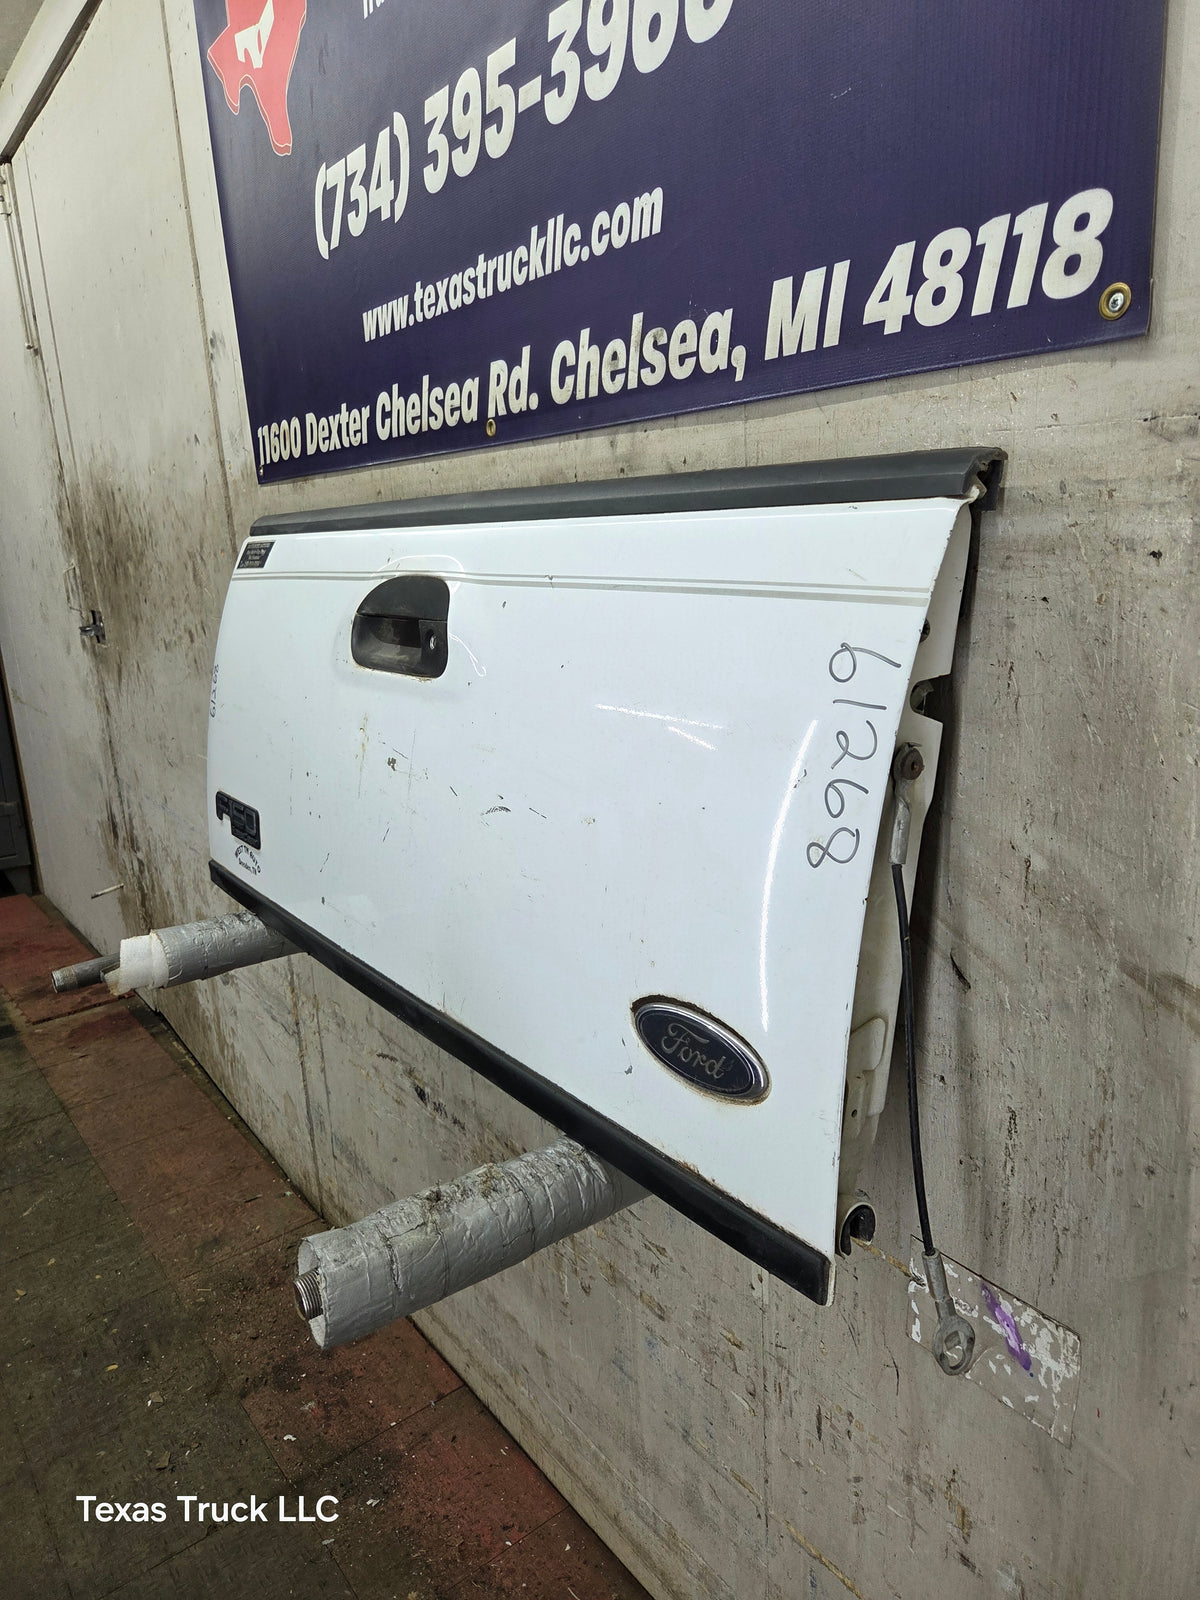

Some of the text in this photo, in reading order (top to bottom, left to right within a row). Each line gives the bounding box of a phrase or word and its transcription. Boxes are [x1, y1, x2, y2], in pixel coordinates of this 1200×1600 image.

[314, 110, 410, 260] (734)
[257, 187, 1114, 466] 11600 Dexter Chelsea Rd. Chelsea, MI 48118
[362, 186, 664, 343] www.texastruckllc.com
[805, 642, 902, 869] 61268
[661, 1022, 728, 1079] Ford
